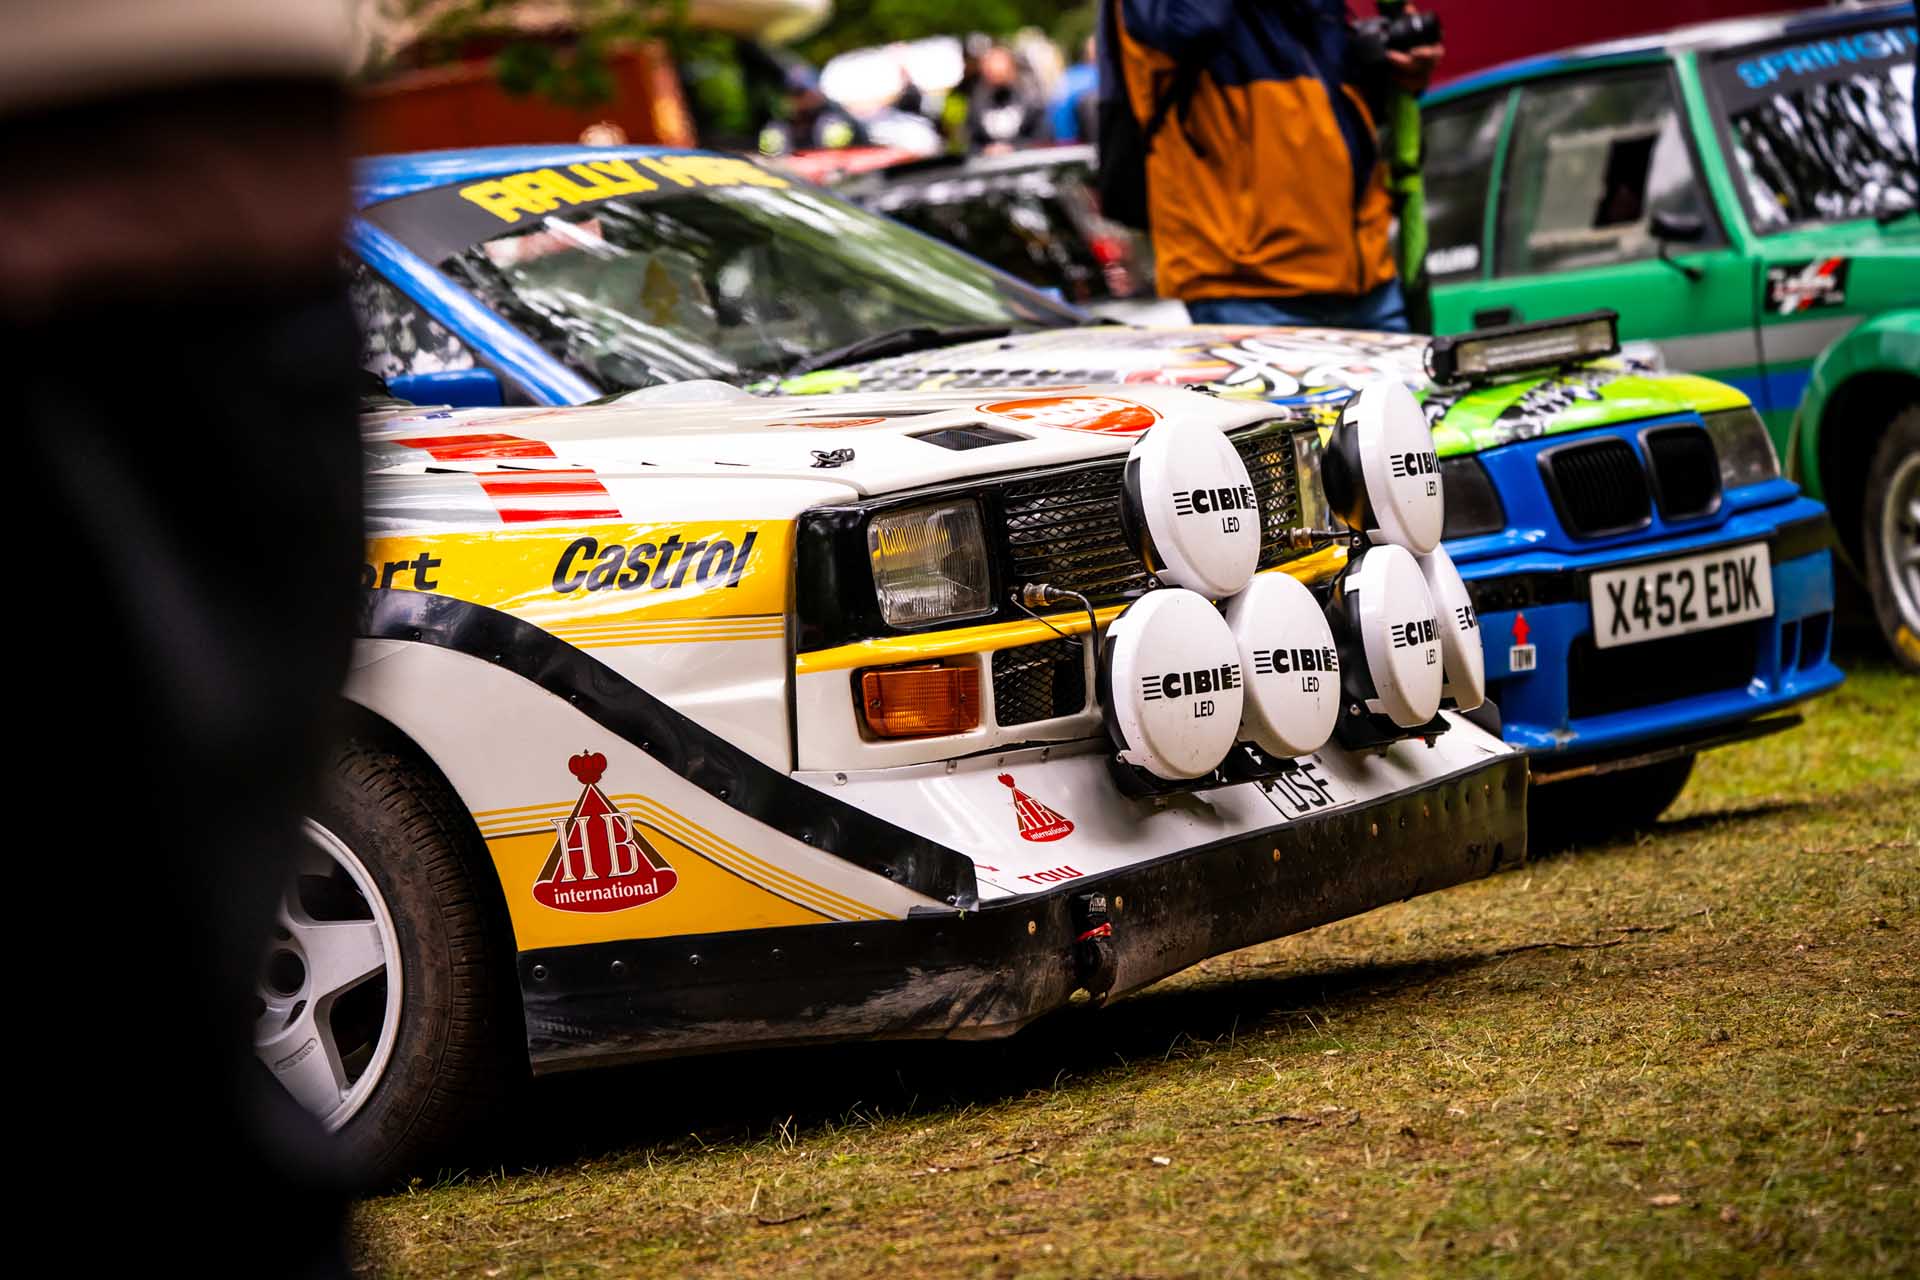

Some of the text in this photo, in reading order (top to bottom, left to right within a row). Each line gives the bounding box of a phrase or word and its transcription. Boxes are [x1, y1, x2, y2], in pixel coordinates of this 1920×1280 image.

[459, 159, 659, 223] RALLY
[1222, 516, 1240, 533] LED
[551, 531, 759, 593] Castrol
[1607, 556, 1761, 635] X452 EDK
[1162, 664, 1233, 699] CIBIÉ
[1302, 676, 1320, 693] LED
[1194, 700, 1215, 718] LED
[1029, 824, 1071, 840] international
[1018, 865, 1085, 885] TOW
[553, 876, 659, 905] international
